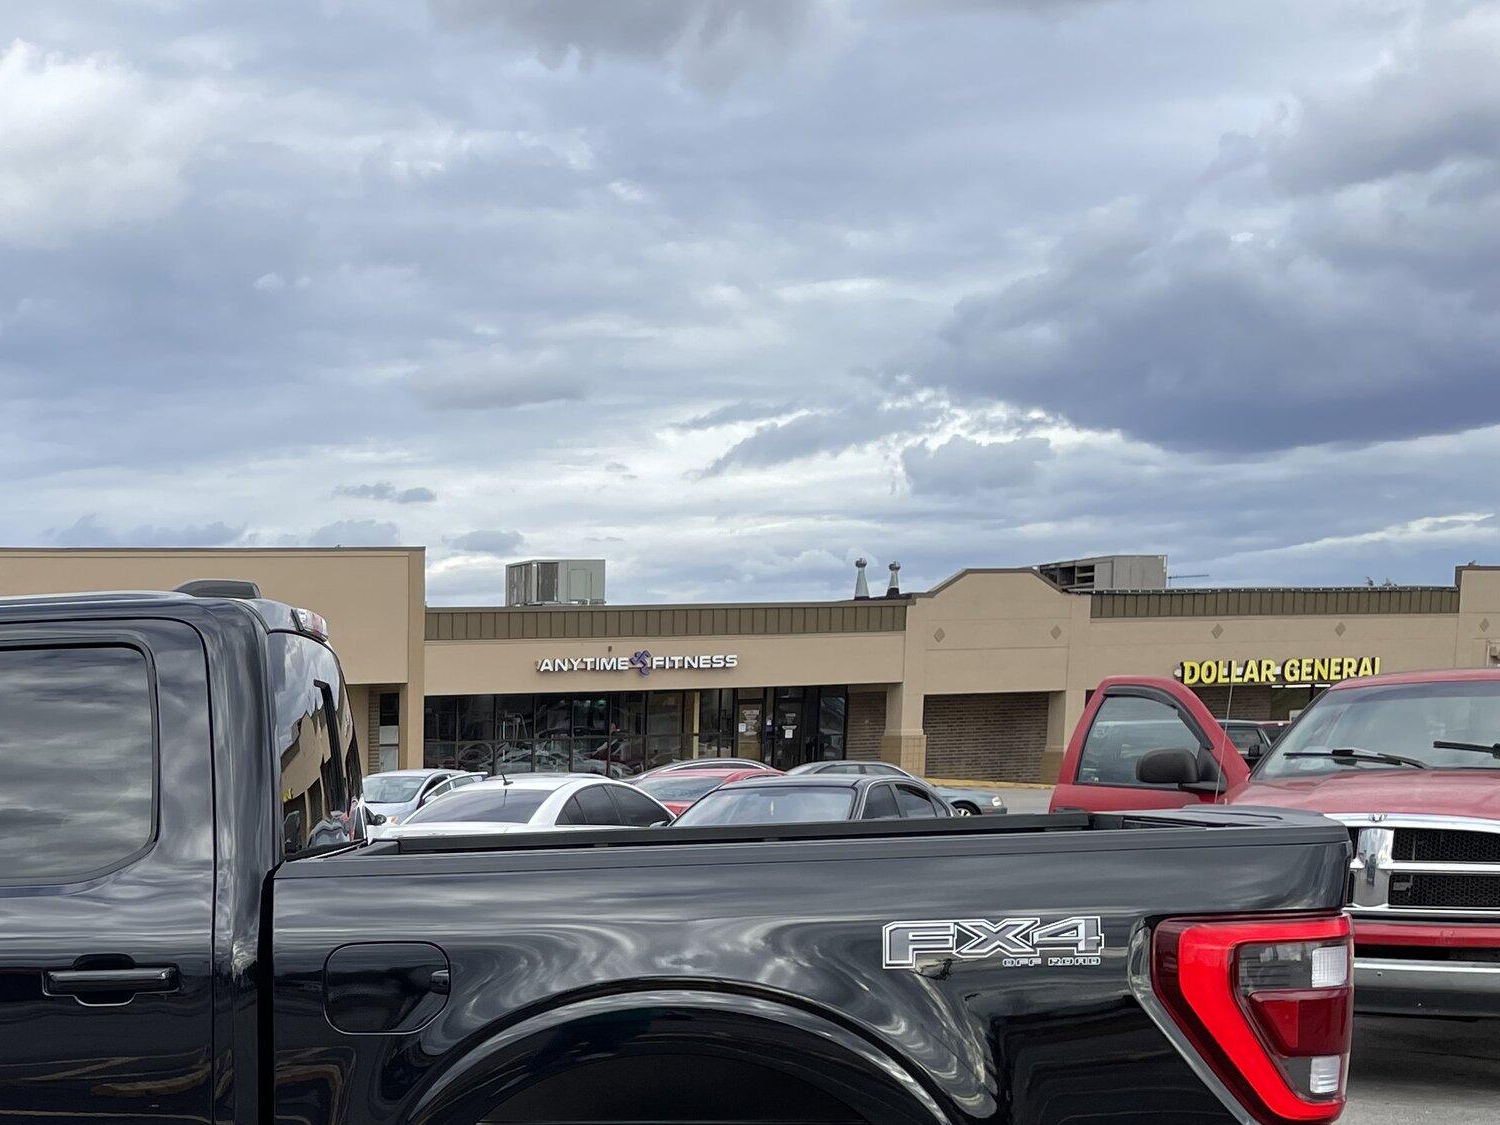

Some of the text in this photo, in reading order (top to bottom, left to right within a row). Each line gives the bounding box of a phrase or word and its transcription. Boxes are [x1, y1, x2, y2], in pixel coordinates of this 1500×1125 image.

[539, 654, 738, 672] ANYTIME FITNESS
[1183, 659, 1276, 685] DOLLAR
[882, 916, 1105, 969] FX4
[1002, 957, 1101, 967] OFF ROAD
